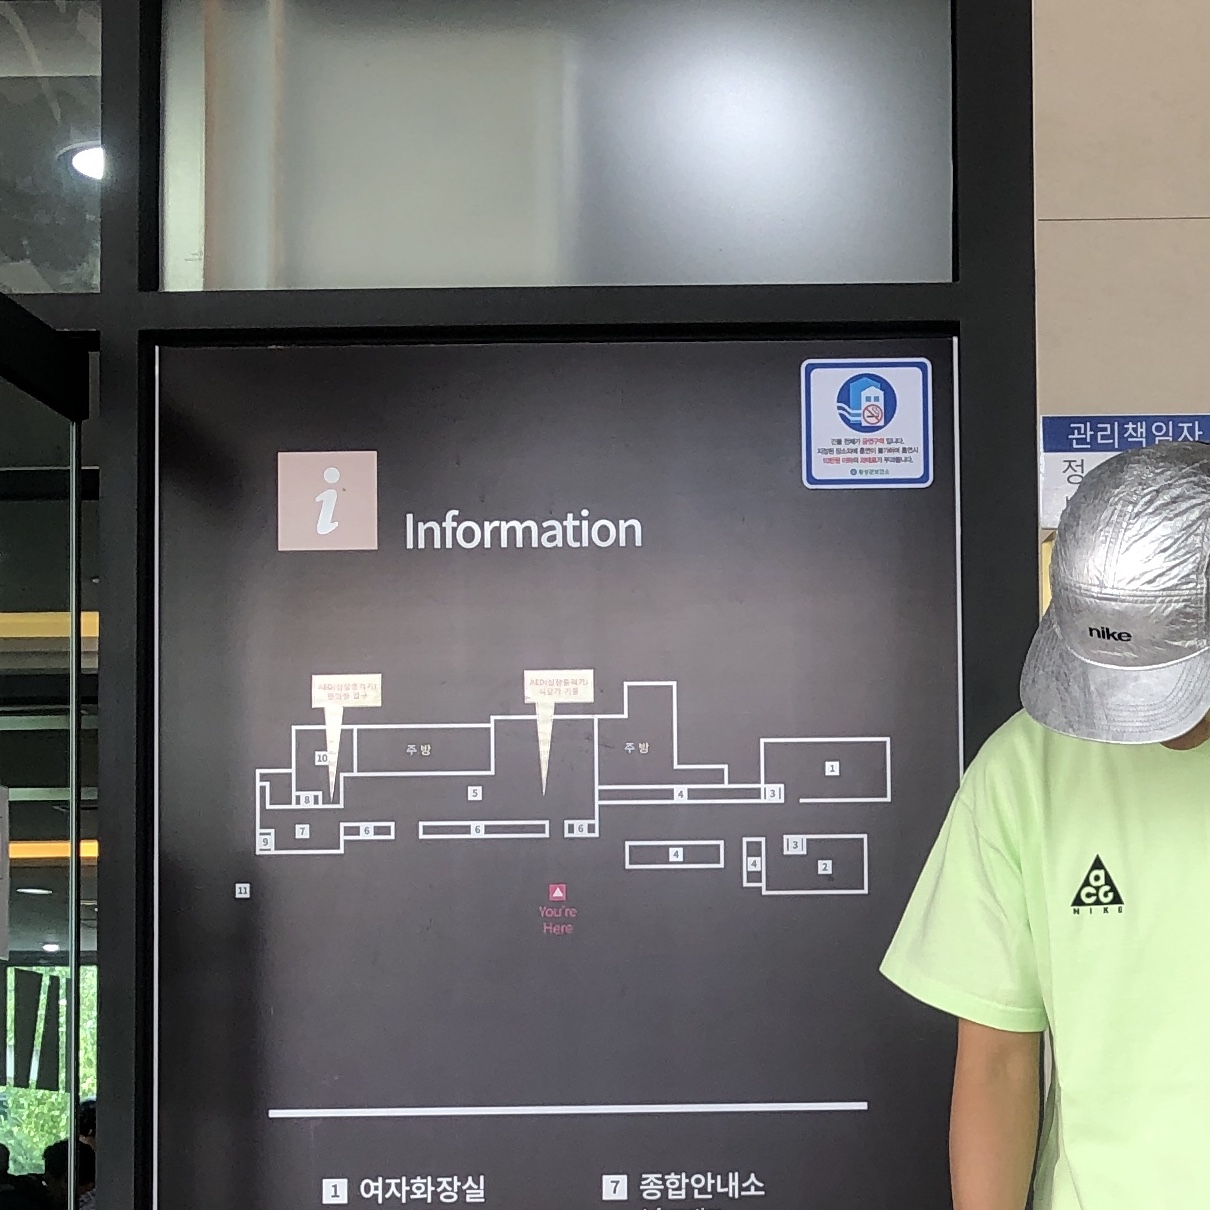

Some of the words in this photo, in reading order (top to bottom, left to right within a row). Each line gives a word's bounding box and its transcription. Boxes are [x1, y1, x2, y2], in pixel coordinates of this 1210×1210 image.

[1068, 420, 1203, 449] 관리책임자
[405, 508, 643, 550] Information
[1088, 626, 1132, 642] nike
[539, 906, 577, 918] You're
[543, 923, 573, 935] Here
[330, 1183, 341, 1198] 1
[359, 1175, 486, 1204] 여자화장실
[610, 1180, 620, 1195] 7
[640, 1171, 766, 1200] 종합안내소
